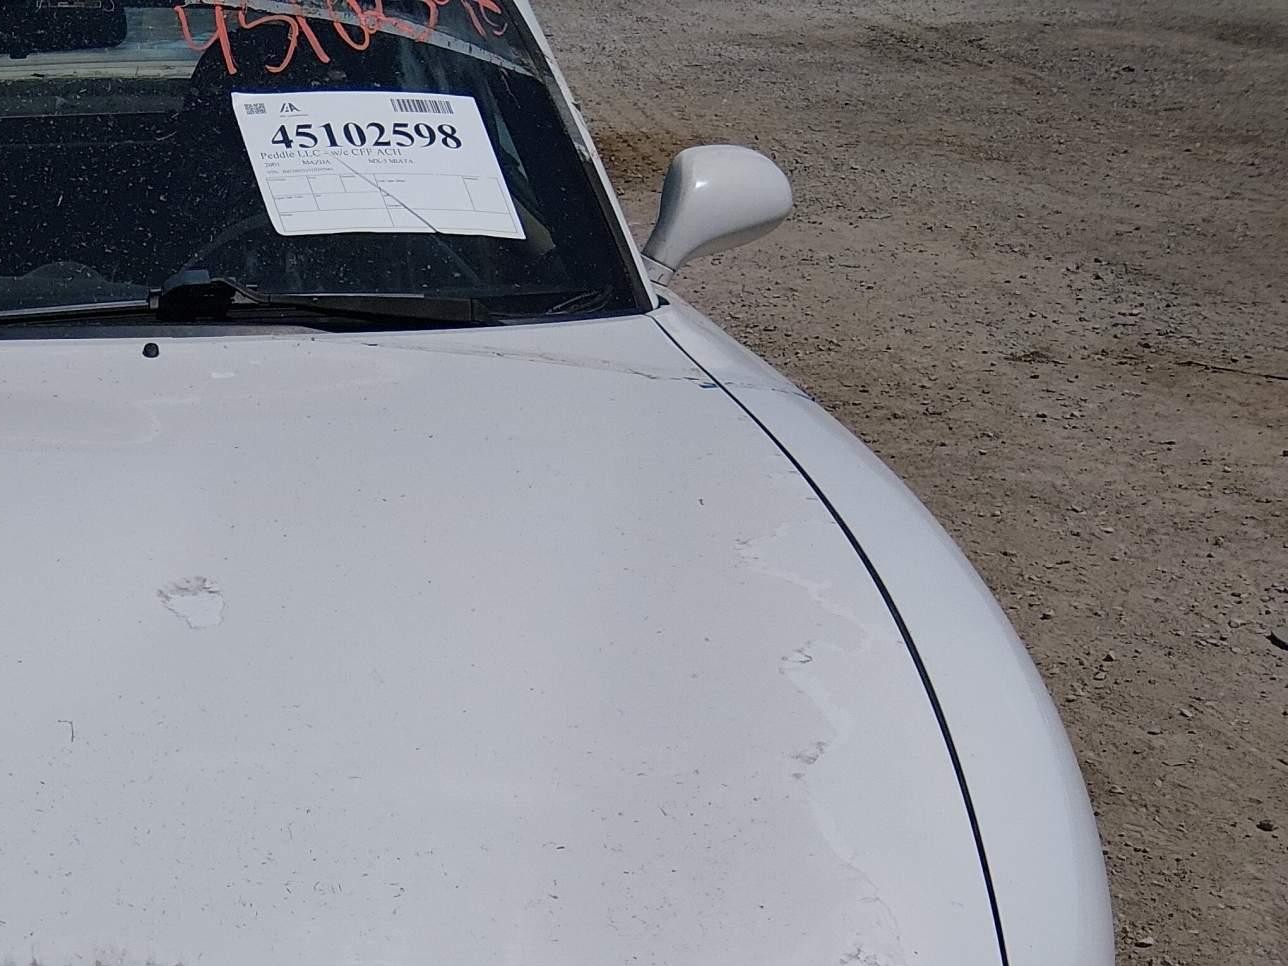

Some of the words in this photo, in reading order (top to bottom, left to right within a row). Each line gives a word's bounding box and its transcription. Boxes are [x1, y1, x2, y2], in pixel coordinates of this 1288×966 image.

[271, 122, 462, 149] 45102598
[260, 150, 295, 160] Peddle
[297, 149, 321, 159] LLC
[377, 147, 403, 157] ACH
